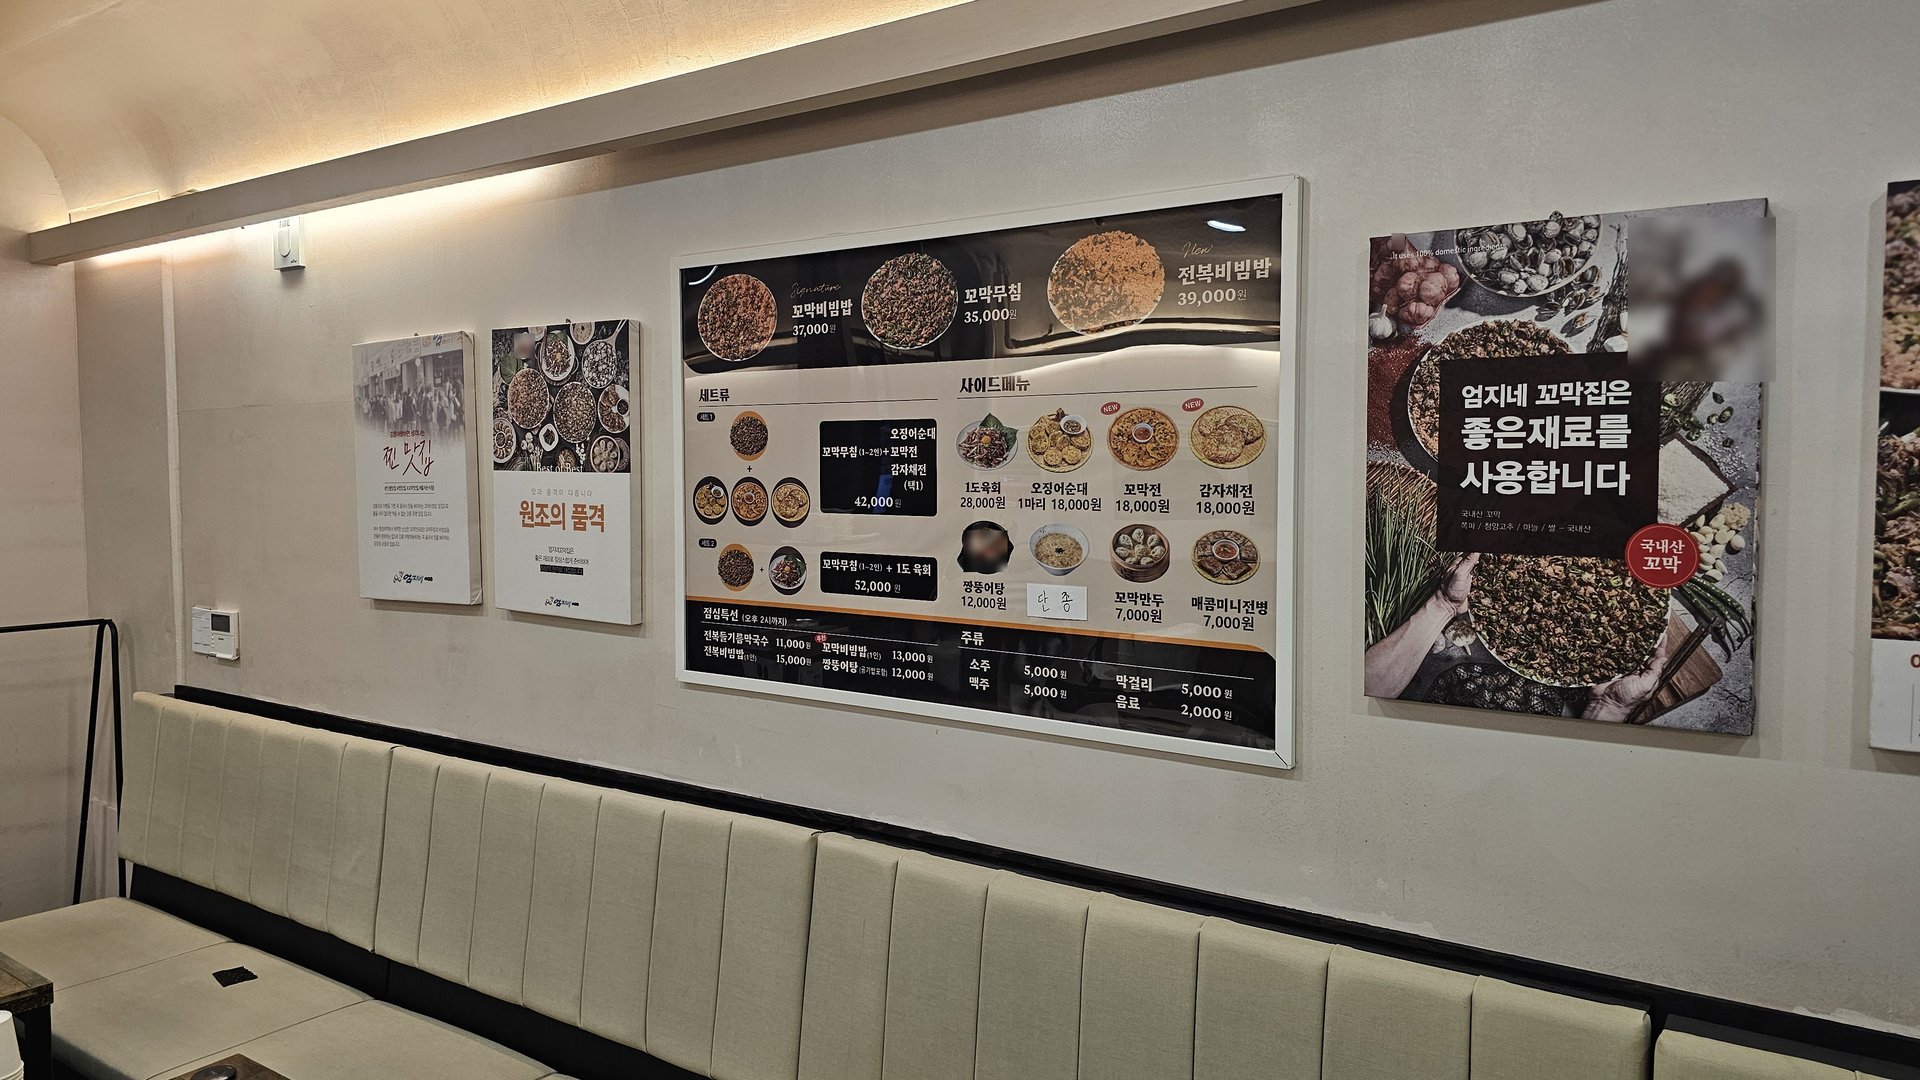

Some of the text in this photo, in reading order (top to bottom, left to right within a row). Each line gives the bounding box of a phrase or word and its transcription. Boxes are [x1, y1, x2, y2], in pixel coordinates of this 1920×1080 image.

[1435, 245, 1466, 256] domestic
[1177, 257, 1272, 286] 전복비빔밥
[963, 282, 1022, 304] 꼬막무침
[791, 298, 853, 319] 꼬막비빔밥
[959, 375, 1031, 394] 사이드메뉴
[698, 388, 730, 402] 세트류
[1461, 379, 1632, 409] 엄지네 꼬막집은
[1103, 404, 1118, 415] NEW
[1184, 401, 1201, 412] NEW
[890, 427, 936, 440] 오징어순대
[1461, 413, 1632, 450] 좋은재료를
[402, 439, 434, 477] 맛집
[537, 464, 550, 472] Best
[566, 463, 583, 473] Best
[890, 464, 927, 476] 감자채전
[903, 480, 924, 491] (택1)
[1459, 460, 1631, 496] 사용합니다
[965, 482, 1001, 494] 1도육회
[1030, 482, 1088, 495] 오징어순대
[1123, 483, 1162, 497] 꼬막전
[1199, 484, 1253, 498] 감자채전
[960, 496, 1006, 510] 28,000원
[1018, 497, 1102, 512] 1마리 18,000원
[1116, 500, 1170, 514] 18,000원
[1196, 501, 1255, 516] 18,000원
[519, 500, 605, 533] 원조의 품격
[1461, 510, 1501, 519] 국내산 꼬막
[1567, 524, 1592, 534] 국내산
[1640, 538, 1685, 554] 국내산
[822, 559, 858, 572] 꼬막무침
[1642, 556, 1682, 574] 꼬막
[962, 581, 1005, 595] 짱뚱어탕
[961, 596, 1007, 610] 12,000원
[1114, 592, 1164, 608] 꼬막만두
[1191, 597, 1268, 615] 매콤미니전병
[703, 607, 739, 622] 점심특선
[1115, 608, 1163, 623] 7,000원
[1203, 615, 1255, 631] 7,000원
[703, 630, 769, 647] 전복들기름막국수
[960, 631, 985, 646] 주류
[969, 658, 991, 672] 소주
[969, 676, 990, 691] 맥주
[1115, 674, 1153, 692] 막걸리
[1115, 694, 1141, 710] 음료
